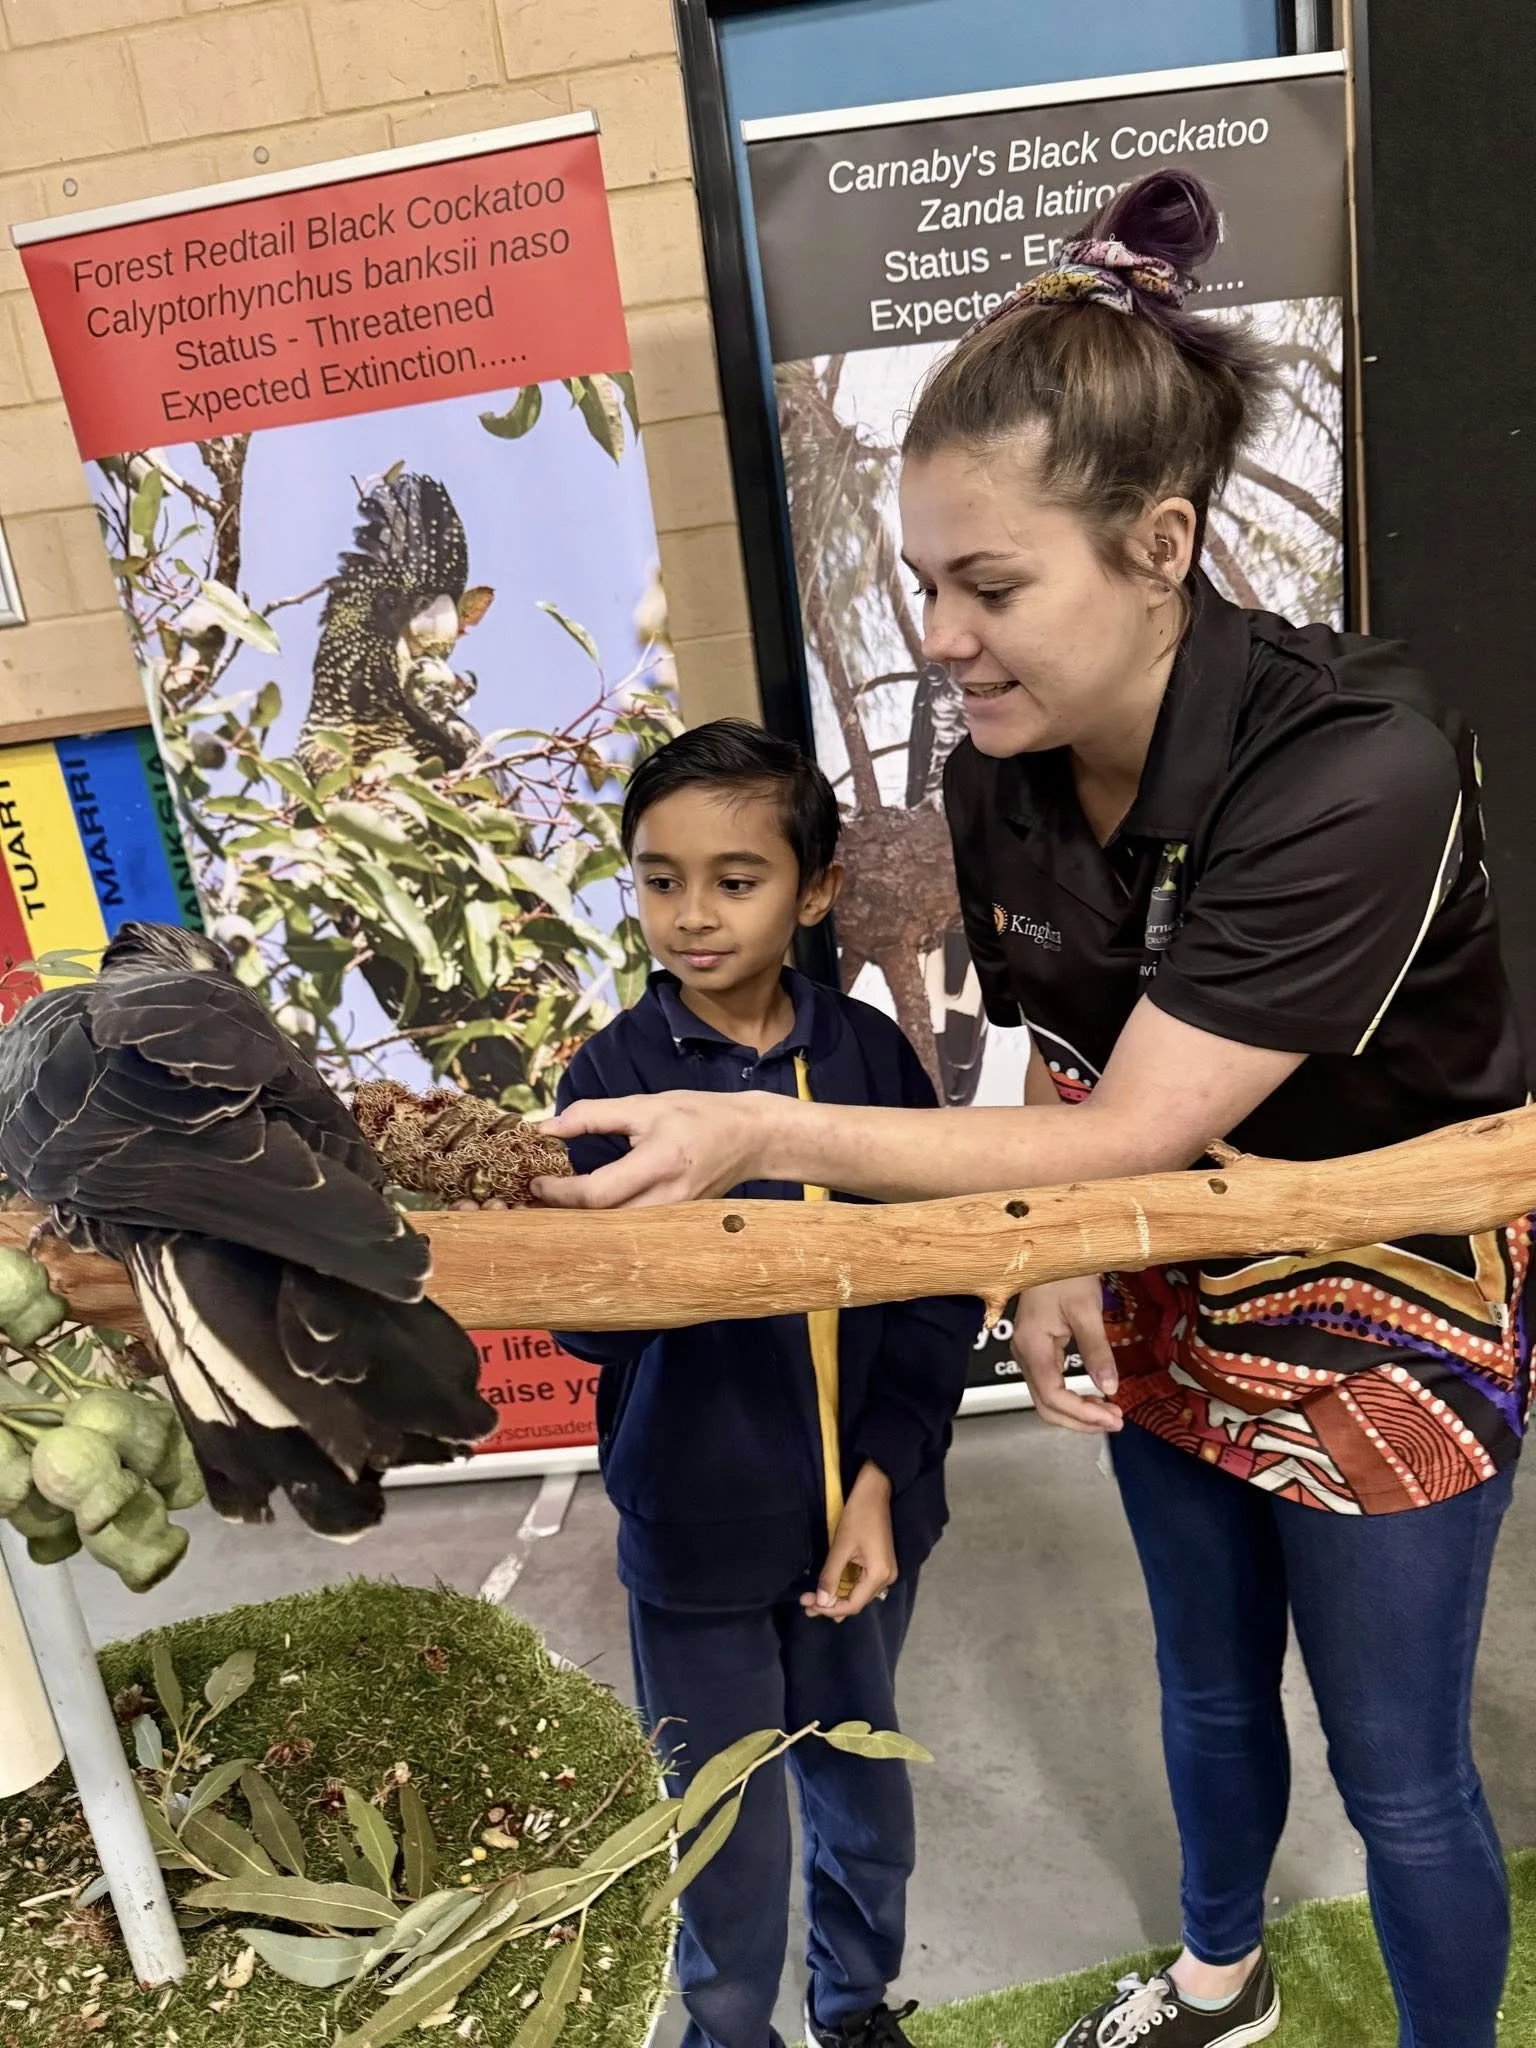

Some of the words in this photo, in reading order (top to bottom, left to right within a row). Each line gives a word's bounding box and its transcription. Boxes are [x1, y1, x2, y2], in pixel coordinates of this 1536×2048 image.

[828, 145, 997, 194] Carnaby's
[1007, 130, 1101, 173] Black
[1109, 116, 1270, 160] Cockatoo
[72, 248, 174, 292] Forest
[184, 221, 296, 272] Redtail
[306, 204, 396, 250] Black
[406, 175, 565, 230] Cockatoo
[917, 190, 1024, 233] Zanda
[86, 264, 353, 338] Calyptorhynchus
[364, 238, 478, 289] banksii
[488, 227, 571, 266] naso
[884, 246, 990, 283] Status
[175, 323, 277, 371] Status
[306, 286, 496, 349] Threatened
[161, 367, 310, 422] Expected
[64, 758, 124, 907] MARRI
